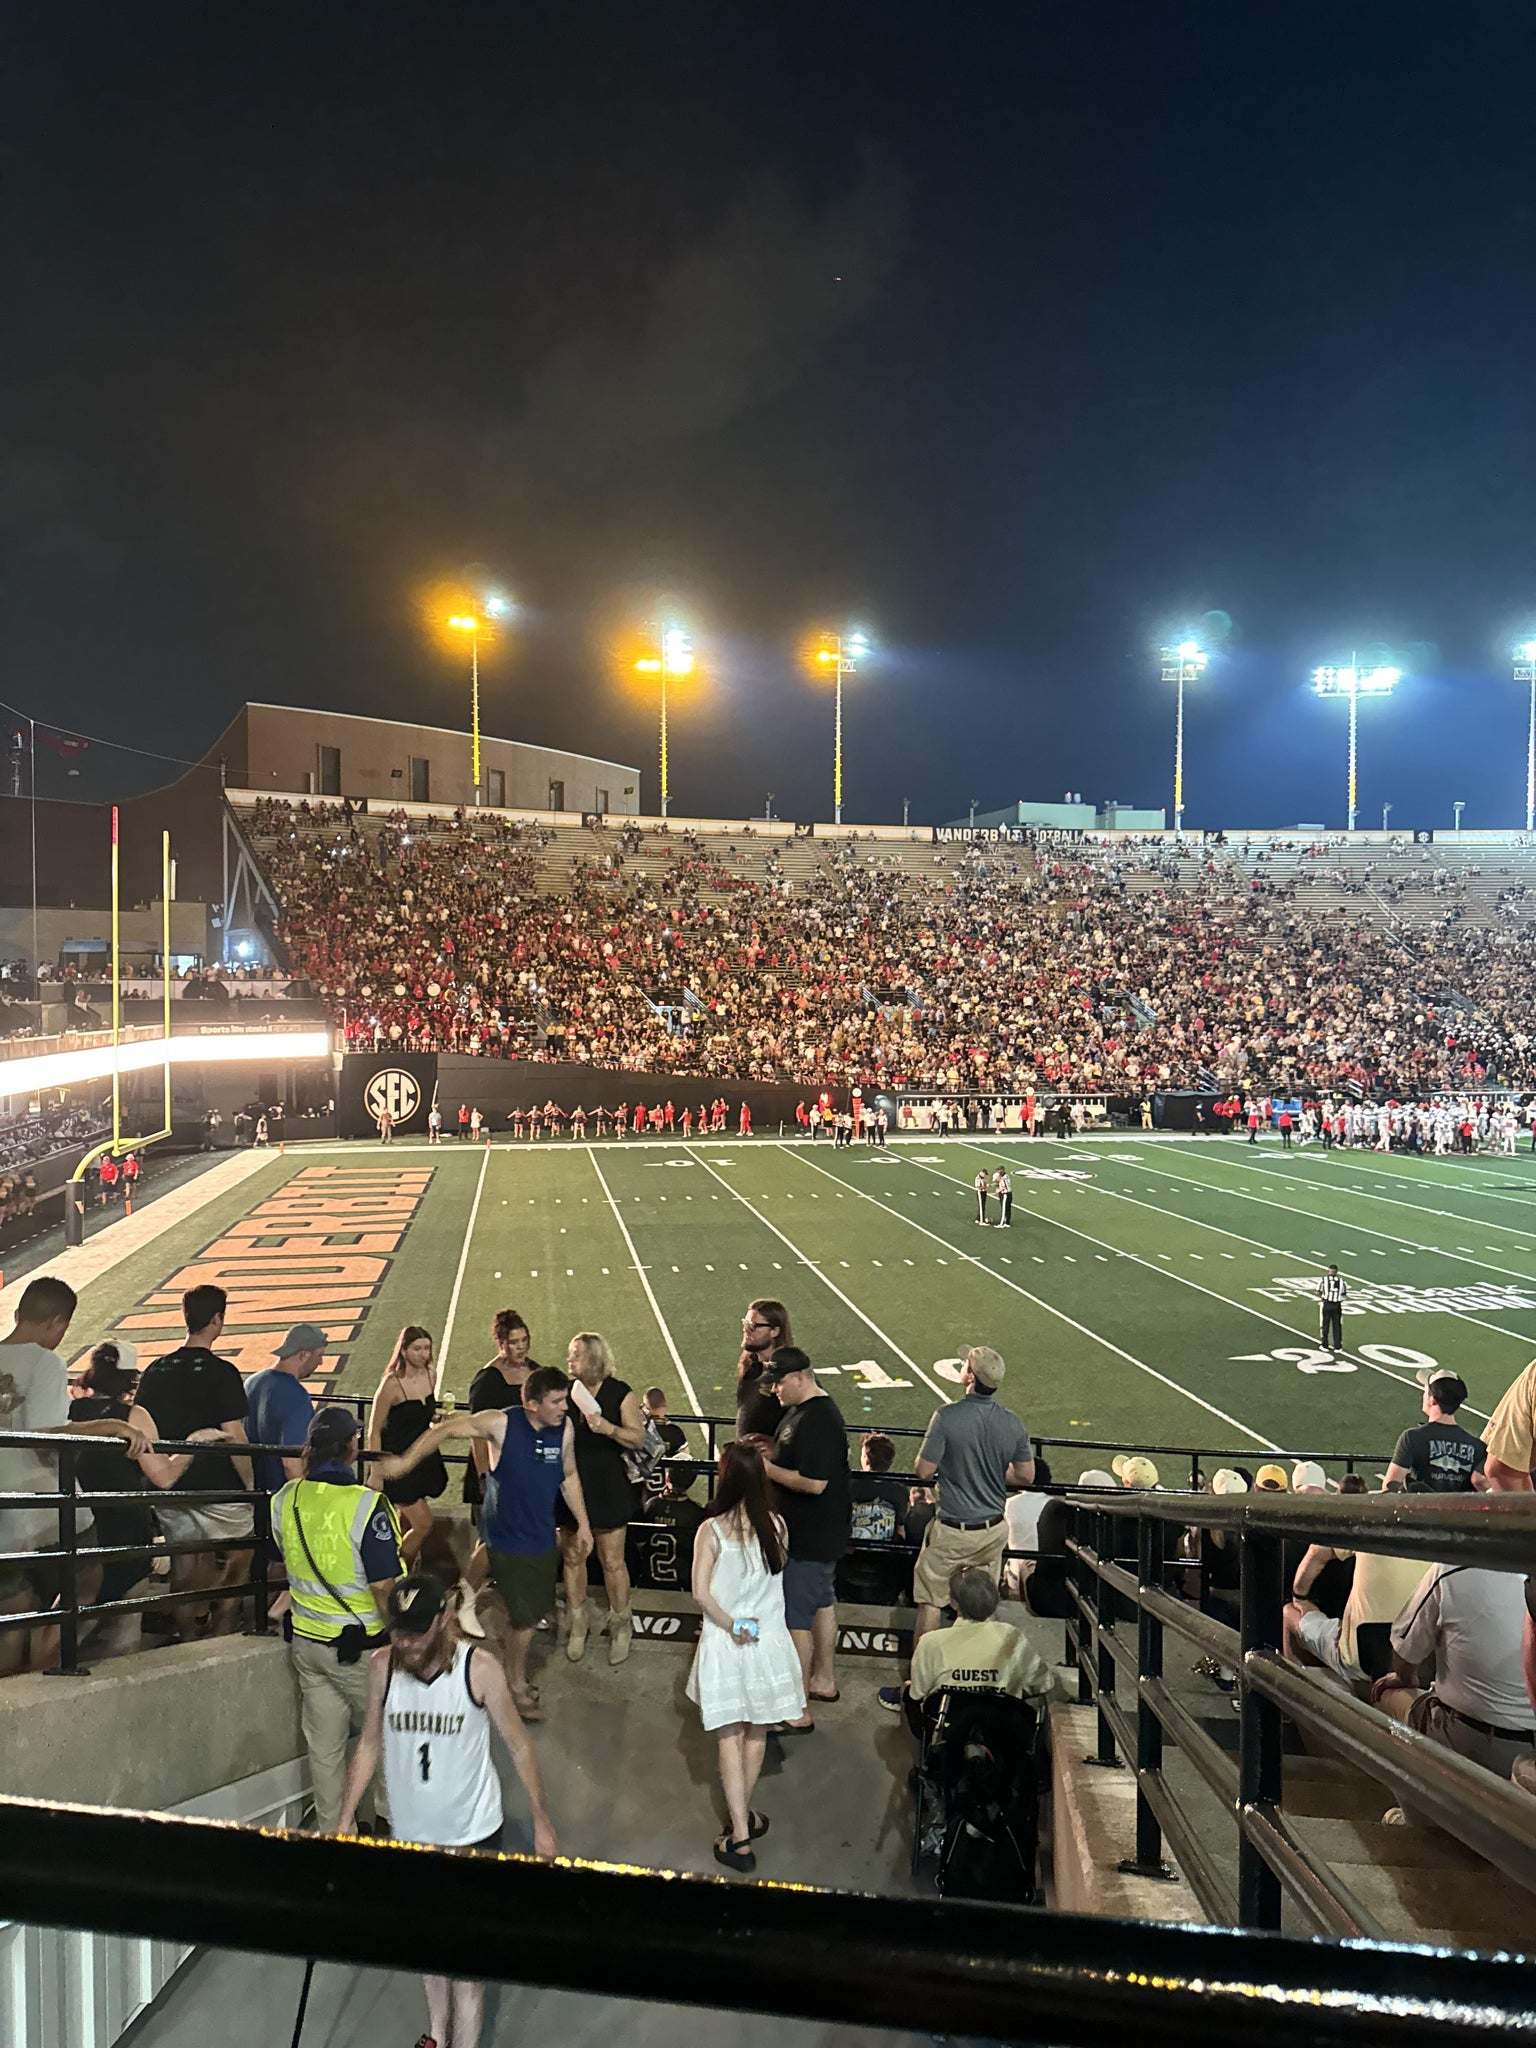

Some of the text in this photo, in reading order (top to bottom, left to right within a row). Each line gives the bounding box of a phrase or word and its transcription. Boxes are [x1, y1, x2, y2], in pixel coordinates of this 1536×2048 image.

[935, 827, 1021, 842] VANDERBLT
[200, 1026, 231, 1035] Sports
[369, 1073, 417, 1120] SEC
[1270, 1344, 1439, 1374] 20
[1429, 1440, 1475, 1463] ANGLER
[650, 1533, 678, 1581] 2
[398, 1588, 421, 1612] V
[951, 1669, 999, 1682] GUEST
[418, 1741, 431, 1783] 1
